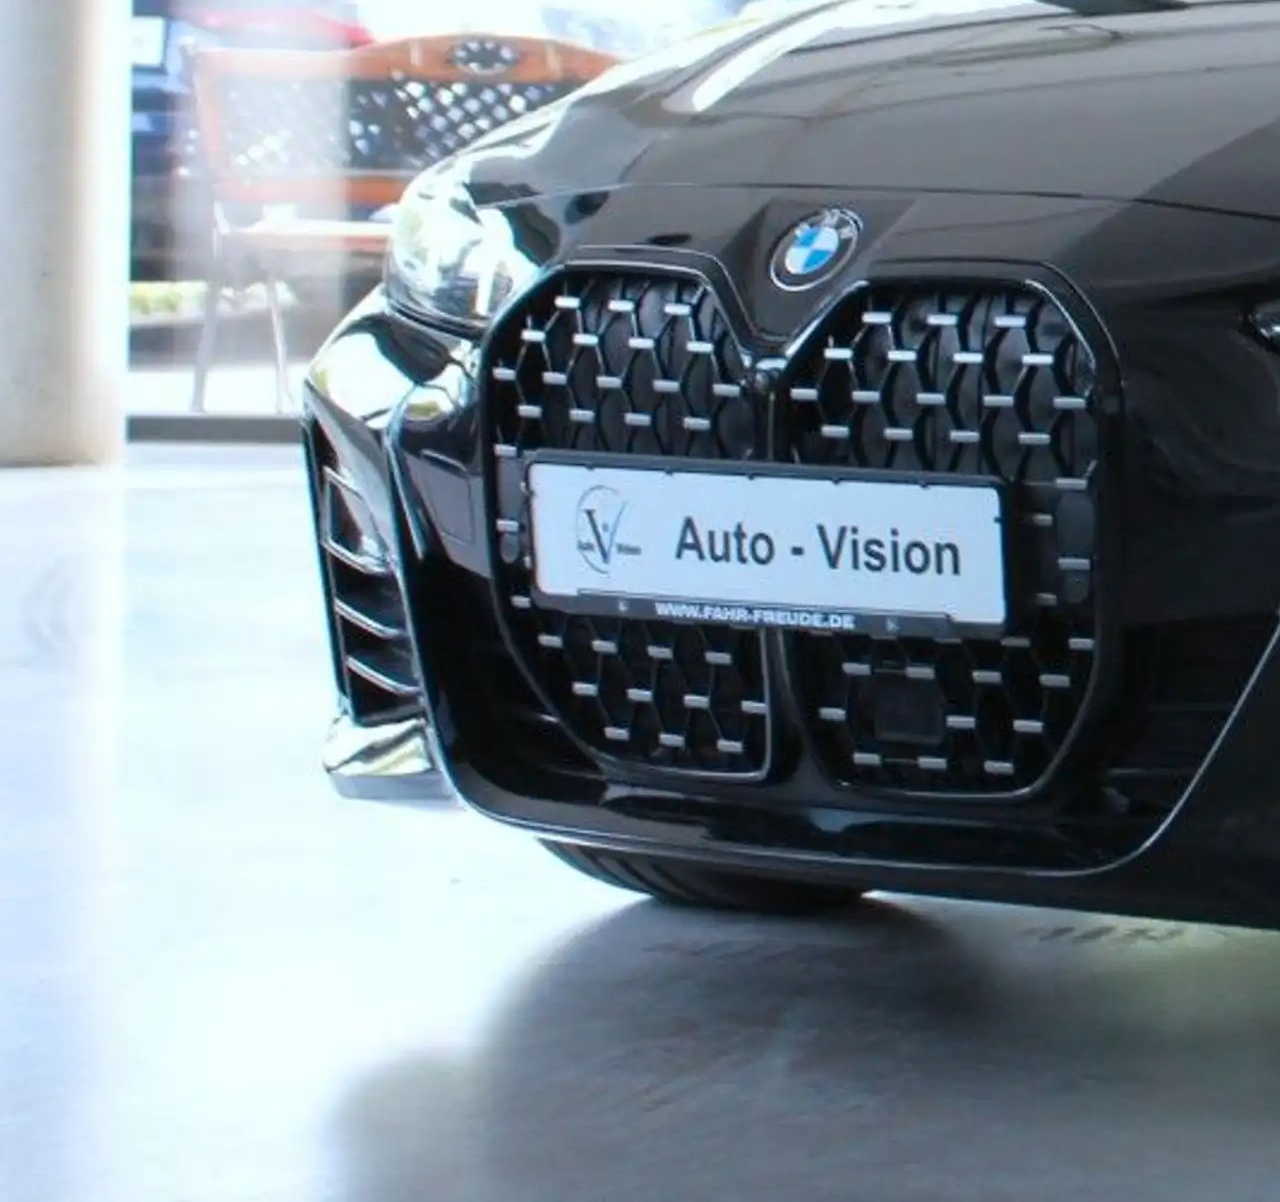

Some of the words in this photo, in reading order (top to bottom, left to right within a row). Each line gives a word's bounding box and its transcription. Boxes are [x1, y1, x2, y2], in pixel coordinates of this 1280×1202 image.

[675, 515, 775, 565] Auto
[790, 546, 805, 556] -
[816, 523, 961, 576] Vision
[654, 601, 856, 629] WWW.FAHR-FREUDE.DE
